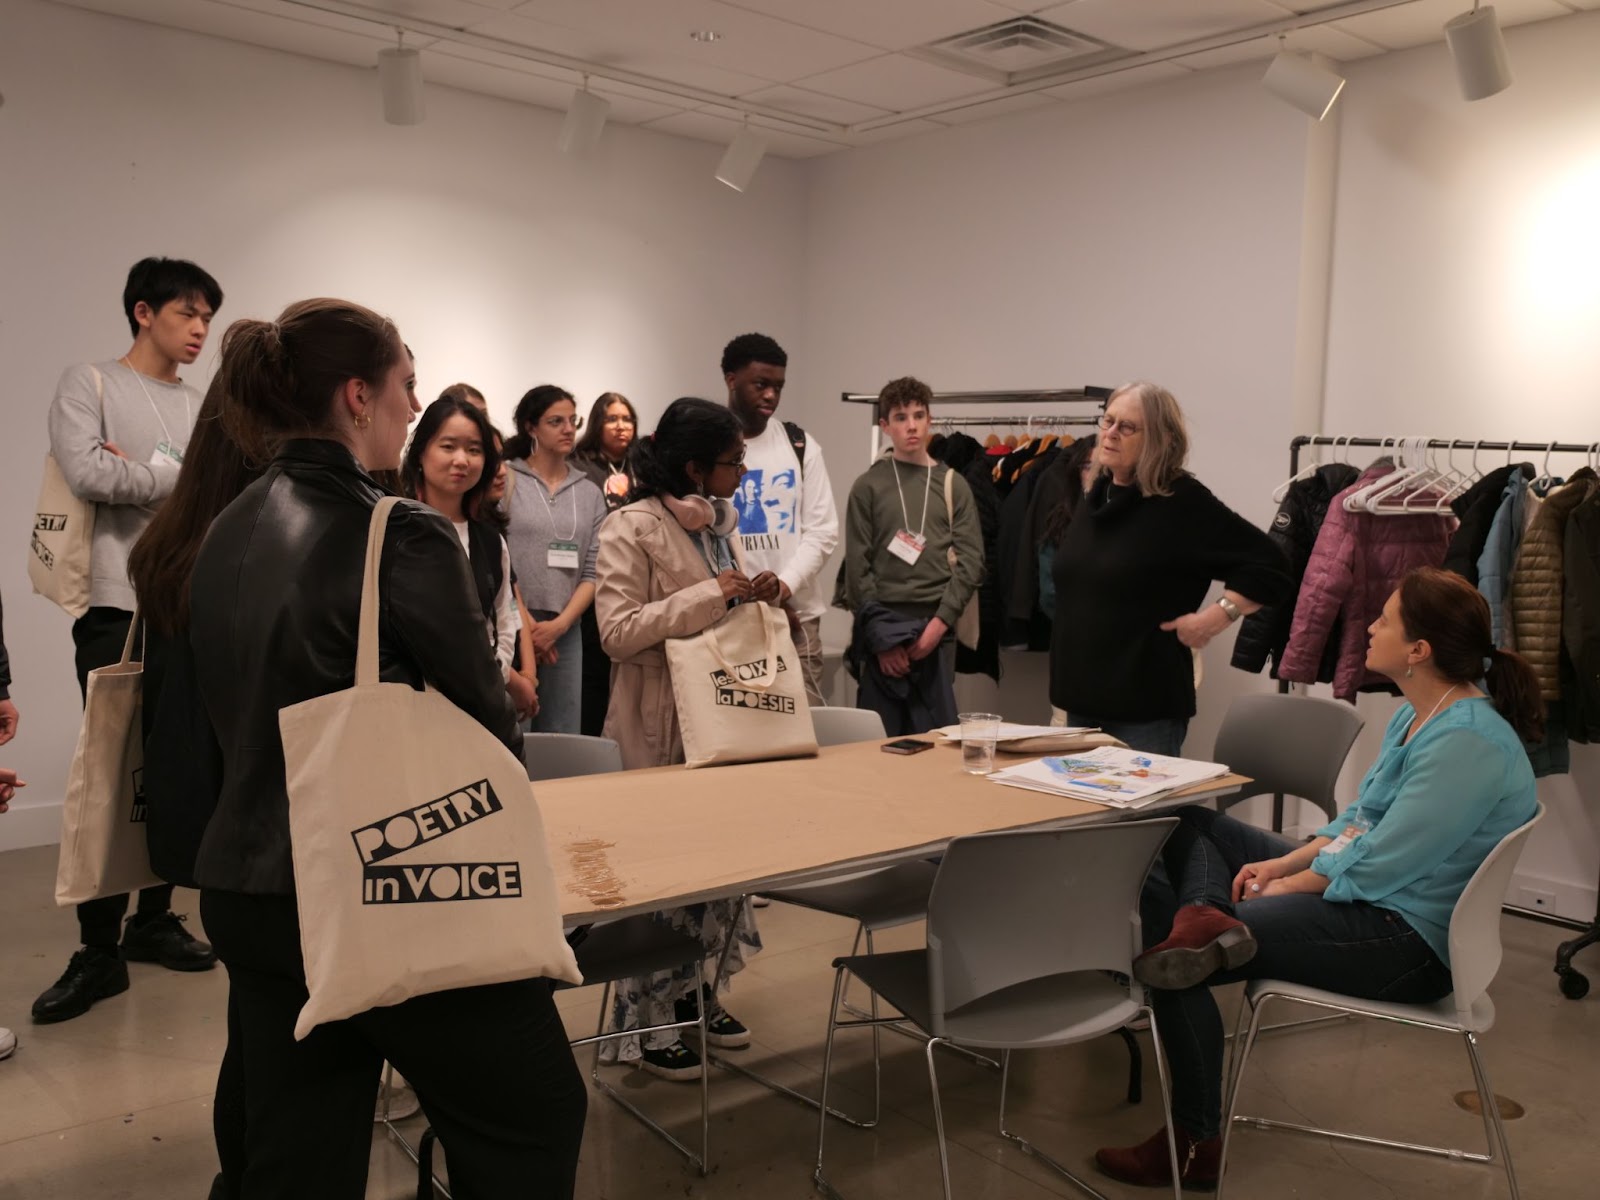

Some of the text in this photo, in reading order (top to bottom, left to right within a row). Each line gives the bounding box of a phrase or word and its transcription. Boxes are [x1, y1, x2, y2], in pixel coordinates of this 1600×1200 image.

[32, 514, 67, 530] OETRY
[740, 534, 779, 550] IRVANA
[717, 689, 732, 704] la
[354, 781, 493, 863] POETRY
[364, 864, 520, 901] in VOICE
